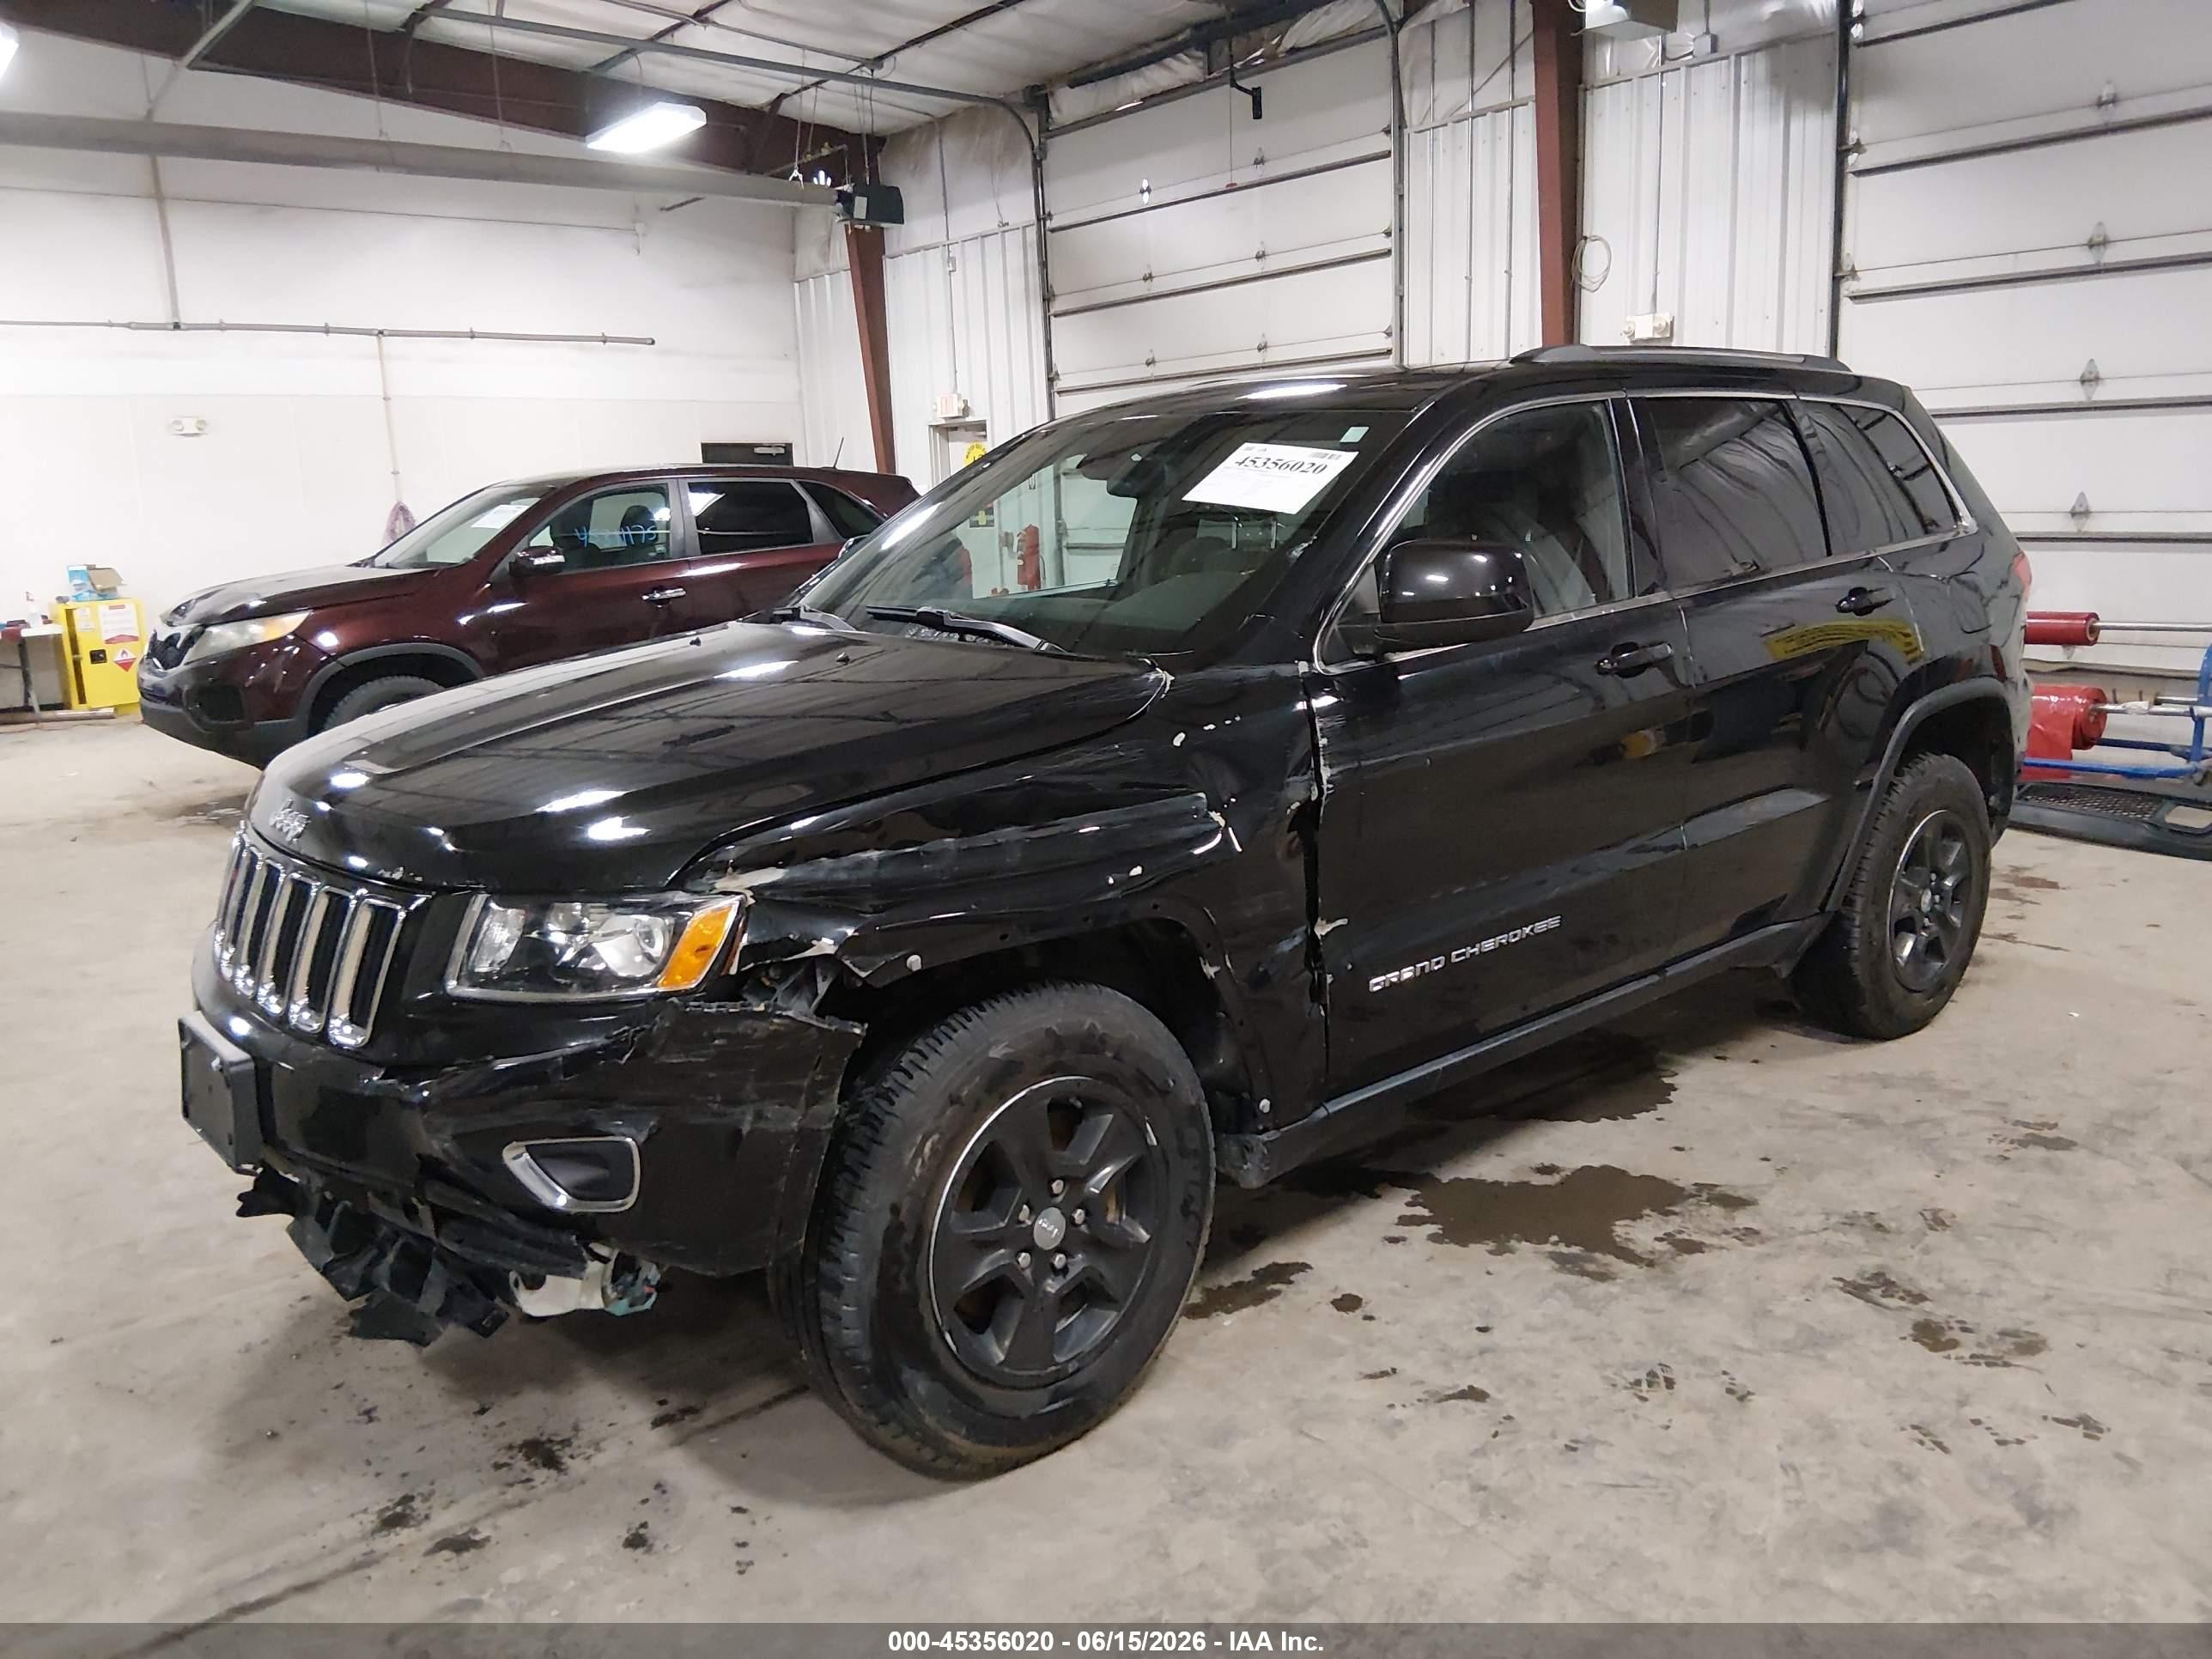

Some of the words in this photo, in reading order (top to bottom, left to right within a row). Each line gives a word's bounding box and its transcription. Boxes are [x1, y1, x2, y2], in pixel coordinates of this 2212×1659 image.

[1235, 455, 1328, 475] 45356020
[1369, 955, 1445, 993] GRAND
[1450, 915, 1561, 963] CHEROKEE
